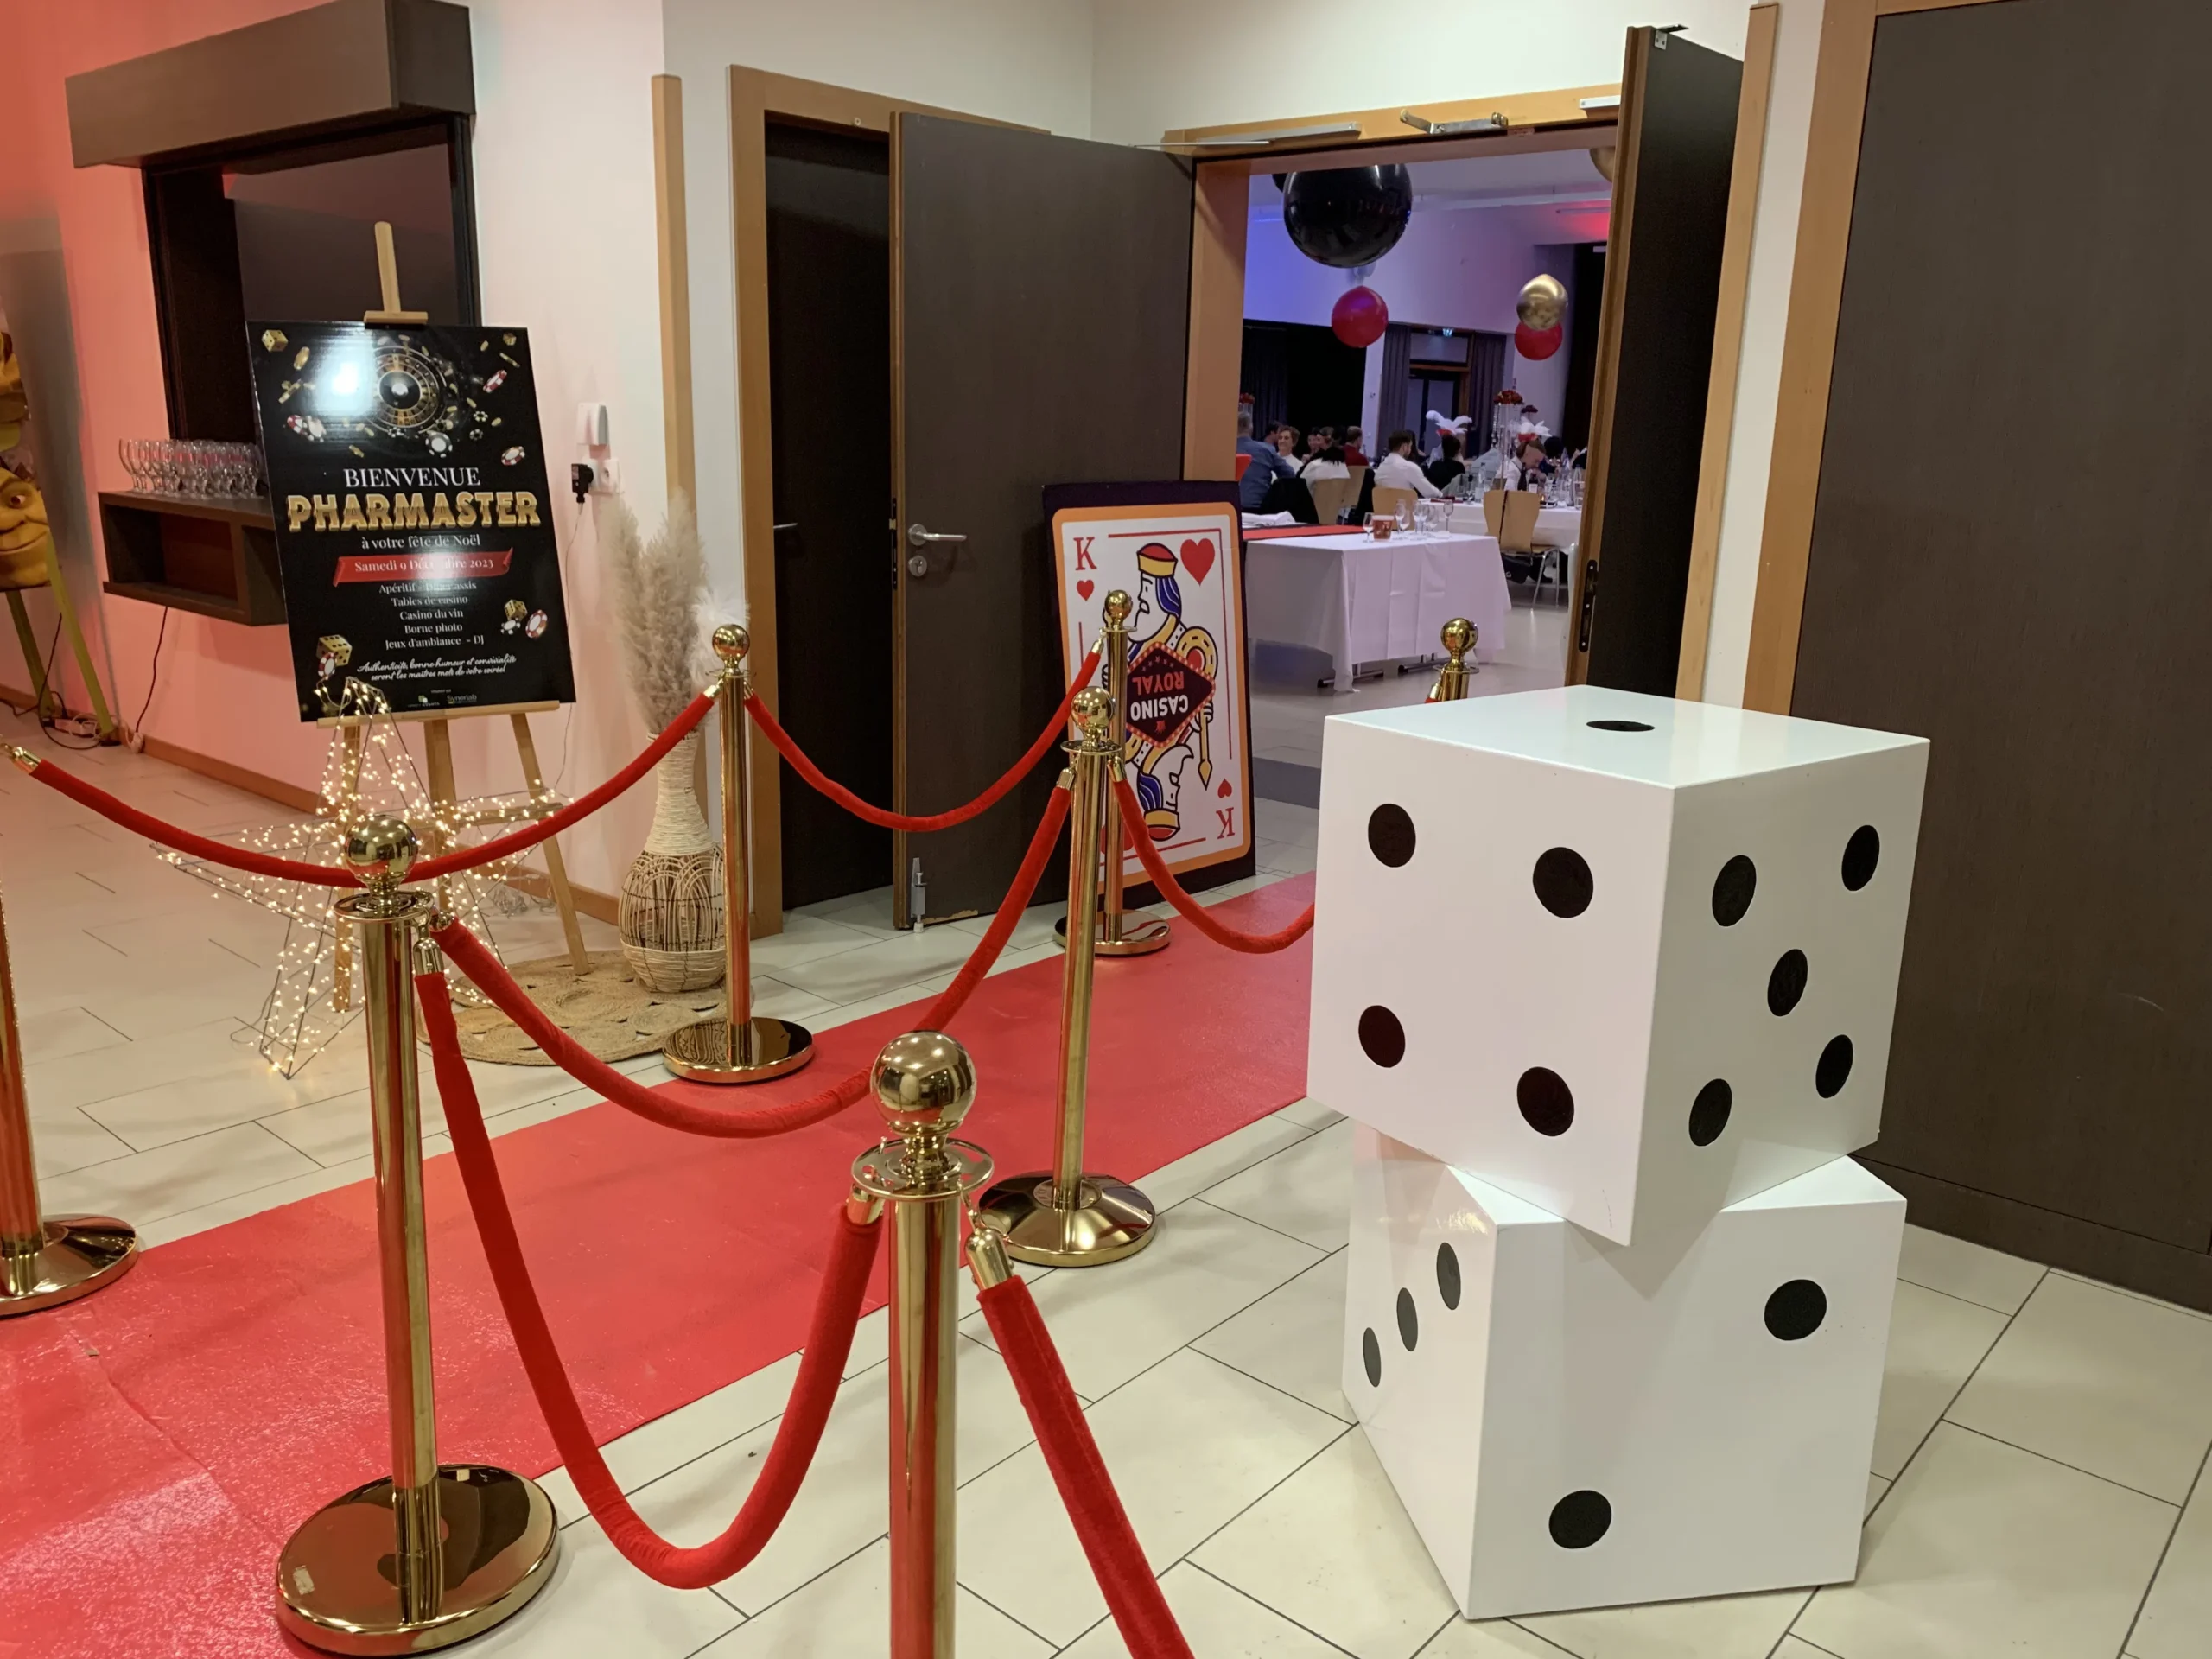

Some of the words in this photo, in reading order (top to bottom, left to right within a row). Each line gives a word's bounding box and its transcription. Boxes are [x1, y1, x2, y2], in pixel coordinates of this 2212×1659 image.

[344, 467, 480, 488] BIENVENUE
[287, 491, 541, 532] PHARMASTER
[361, 537, 370, 550] à
[372, 537, 404, 549] votre
[408, 535, 431, 548] fête
[434, 534, 450, 546] de
[453, 533, 481, 546] Noël
[1072, 536, 1097, 571] K
[354, 559, 397, 573] Samedi
[399, 561, 407, 572] 9
[410, 557, 467, 571] Décbre
[469, 558, 494, 569] 2023
[378, 582, 416, 595] Apéritif
[391, 596, 423, 608] Tables
[424, 596, 435, 607] de
[436, 595, 468, 606] casino
[399, 611, 433, 621] Casino
[435, 610, 447, 620] du
[448, 609, 464, 619] vin
[404, 624, 433, 635] Borne
[435, 623, 463, 634] photo
[385, 639, 406, 651] Jeux
[408, 637, 461, 648] d'ambiance
[473, 635, 485, 645] DJ
[410, 658, 435, 669] bonne
[435, 657, 465, 668] humeur
[467, 657, 475, 665] et
[371, 671, 397, 682] seront
[396, 670, 408, 680] les
[454, 665, 466, 677] de
[465, 665, 483, 676] votre
[1131, 671, 1185, 696] ROYAL
[1130, 695, 1188, 721] CASINO
[1215, 806, 1236, 840] K
